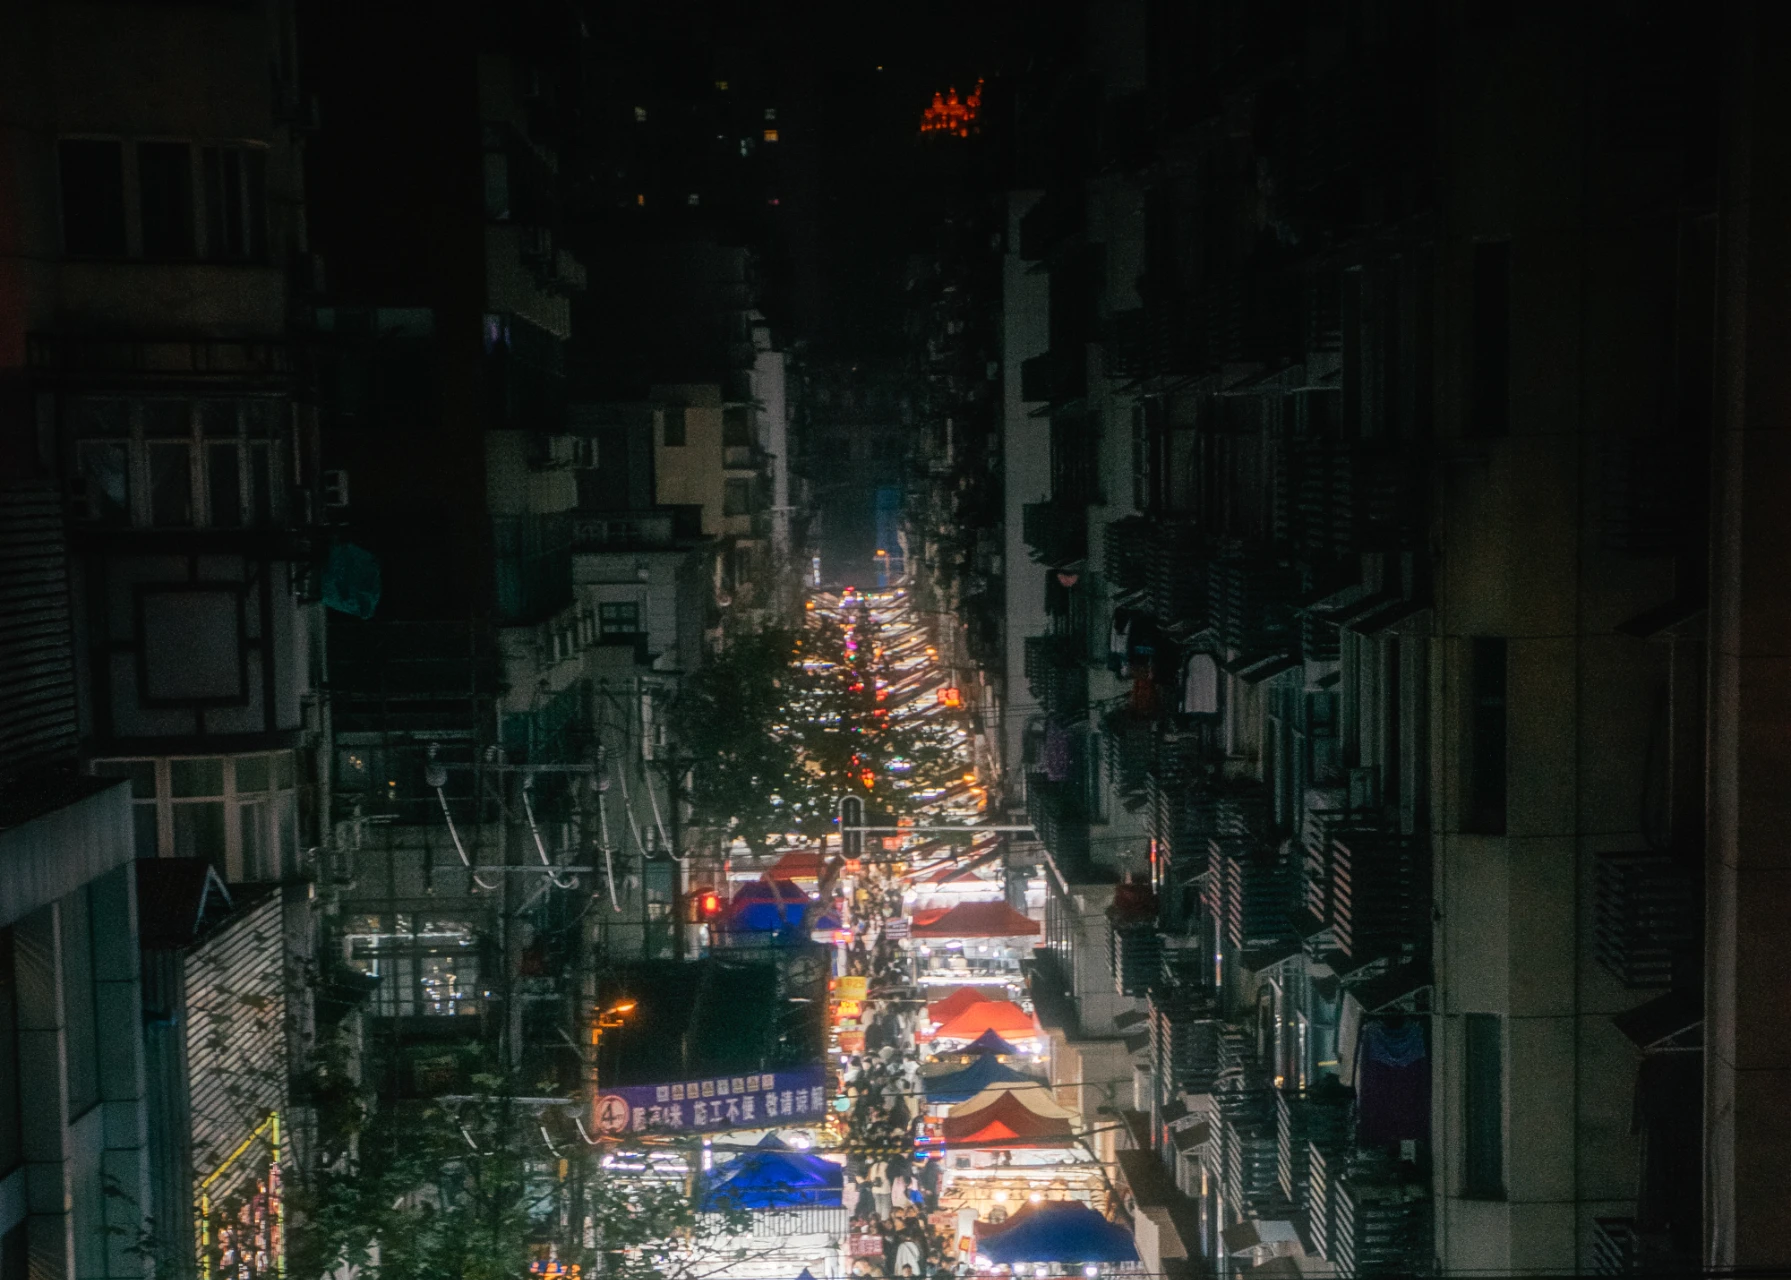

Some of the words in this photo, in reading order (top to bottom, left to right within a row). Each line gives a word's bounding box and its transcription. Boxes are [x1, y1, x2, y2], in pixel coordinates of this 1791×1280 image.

[694, 1096, 755, 1125] 施工不便
[766, 1086, 824, 1117] 敬请谅解
